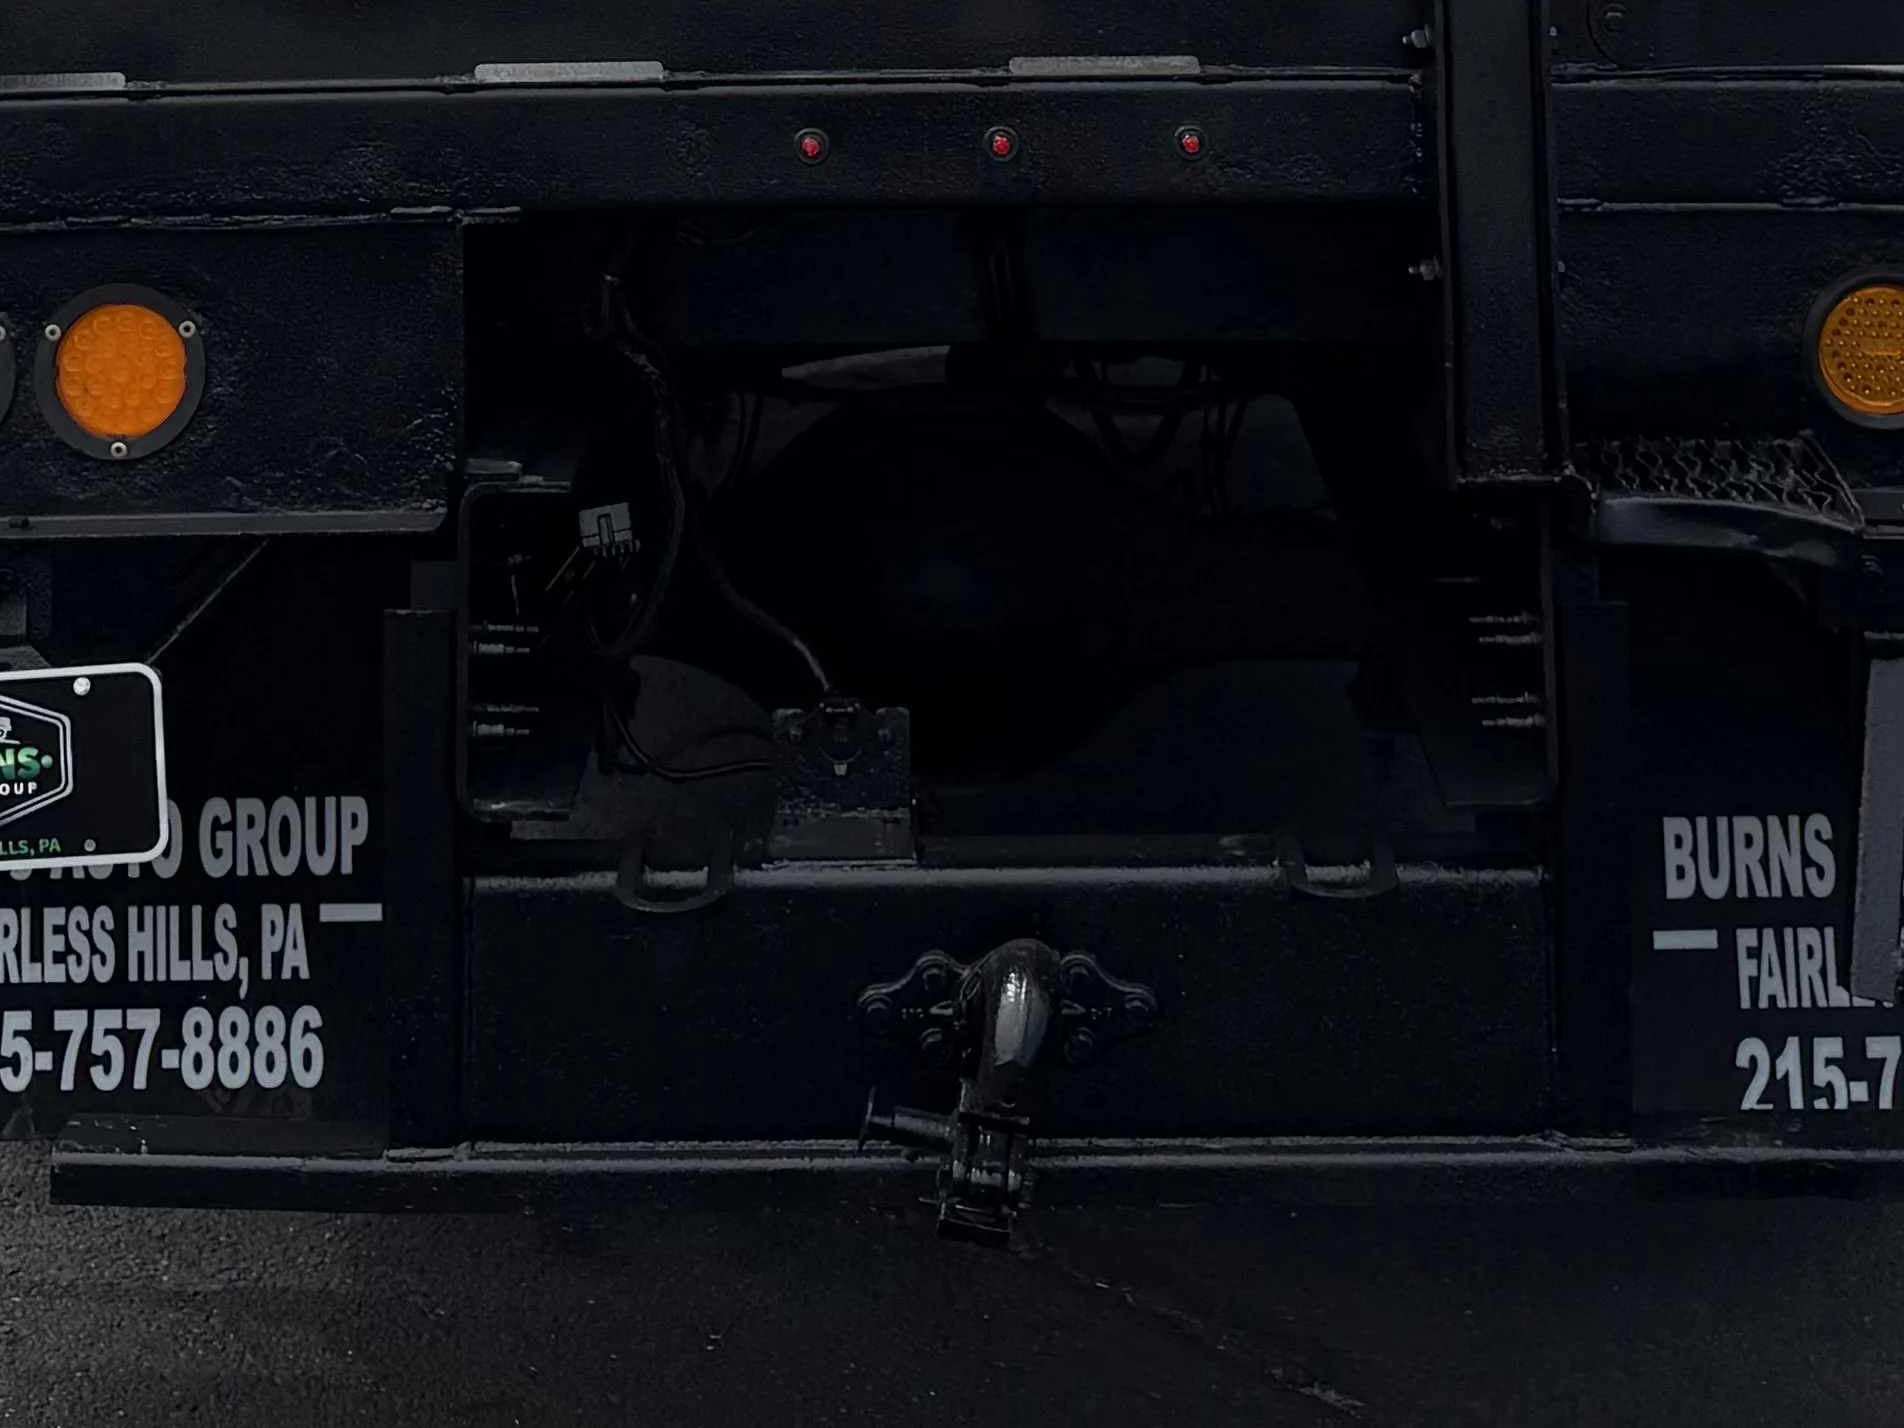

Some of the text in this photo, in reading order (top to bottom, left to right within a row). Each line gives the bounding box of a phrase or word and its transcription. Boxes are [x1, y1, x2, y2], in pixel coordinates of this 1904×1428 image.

[38, 837, 62, 853] PA
[199, 795, 370, 878] GROUP
[1662, 812, 1837, 900] BURNS
[127, 903, 250, 1000] HILLS,
[260, 903, 311, 981] PA
